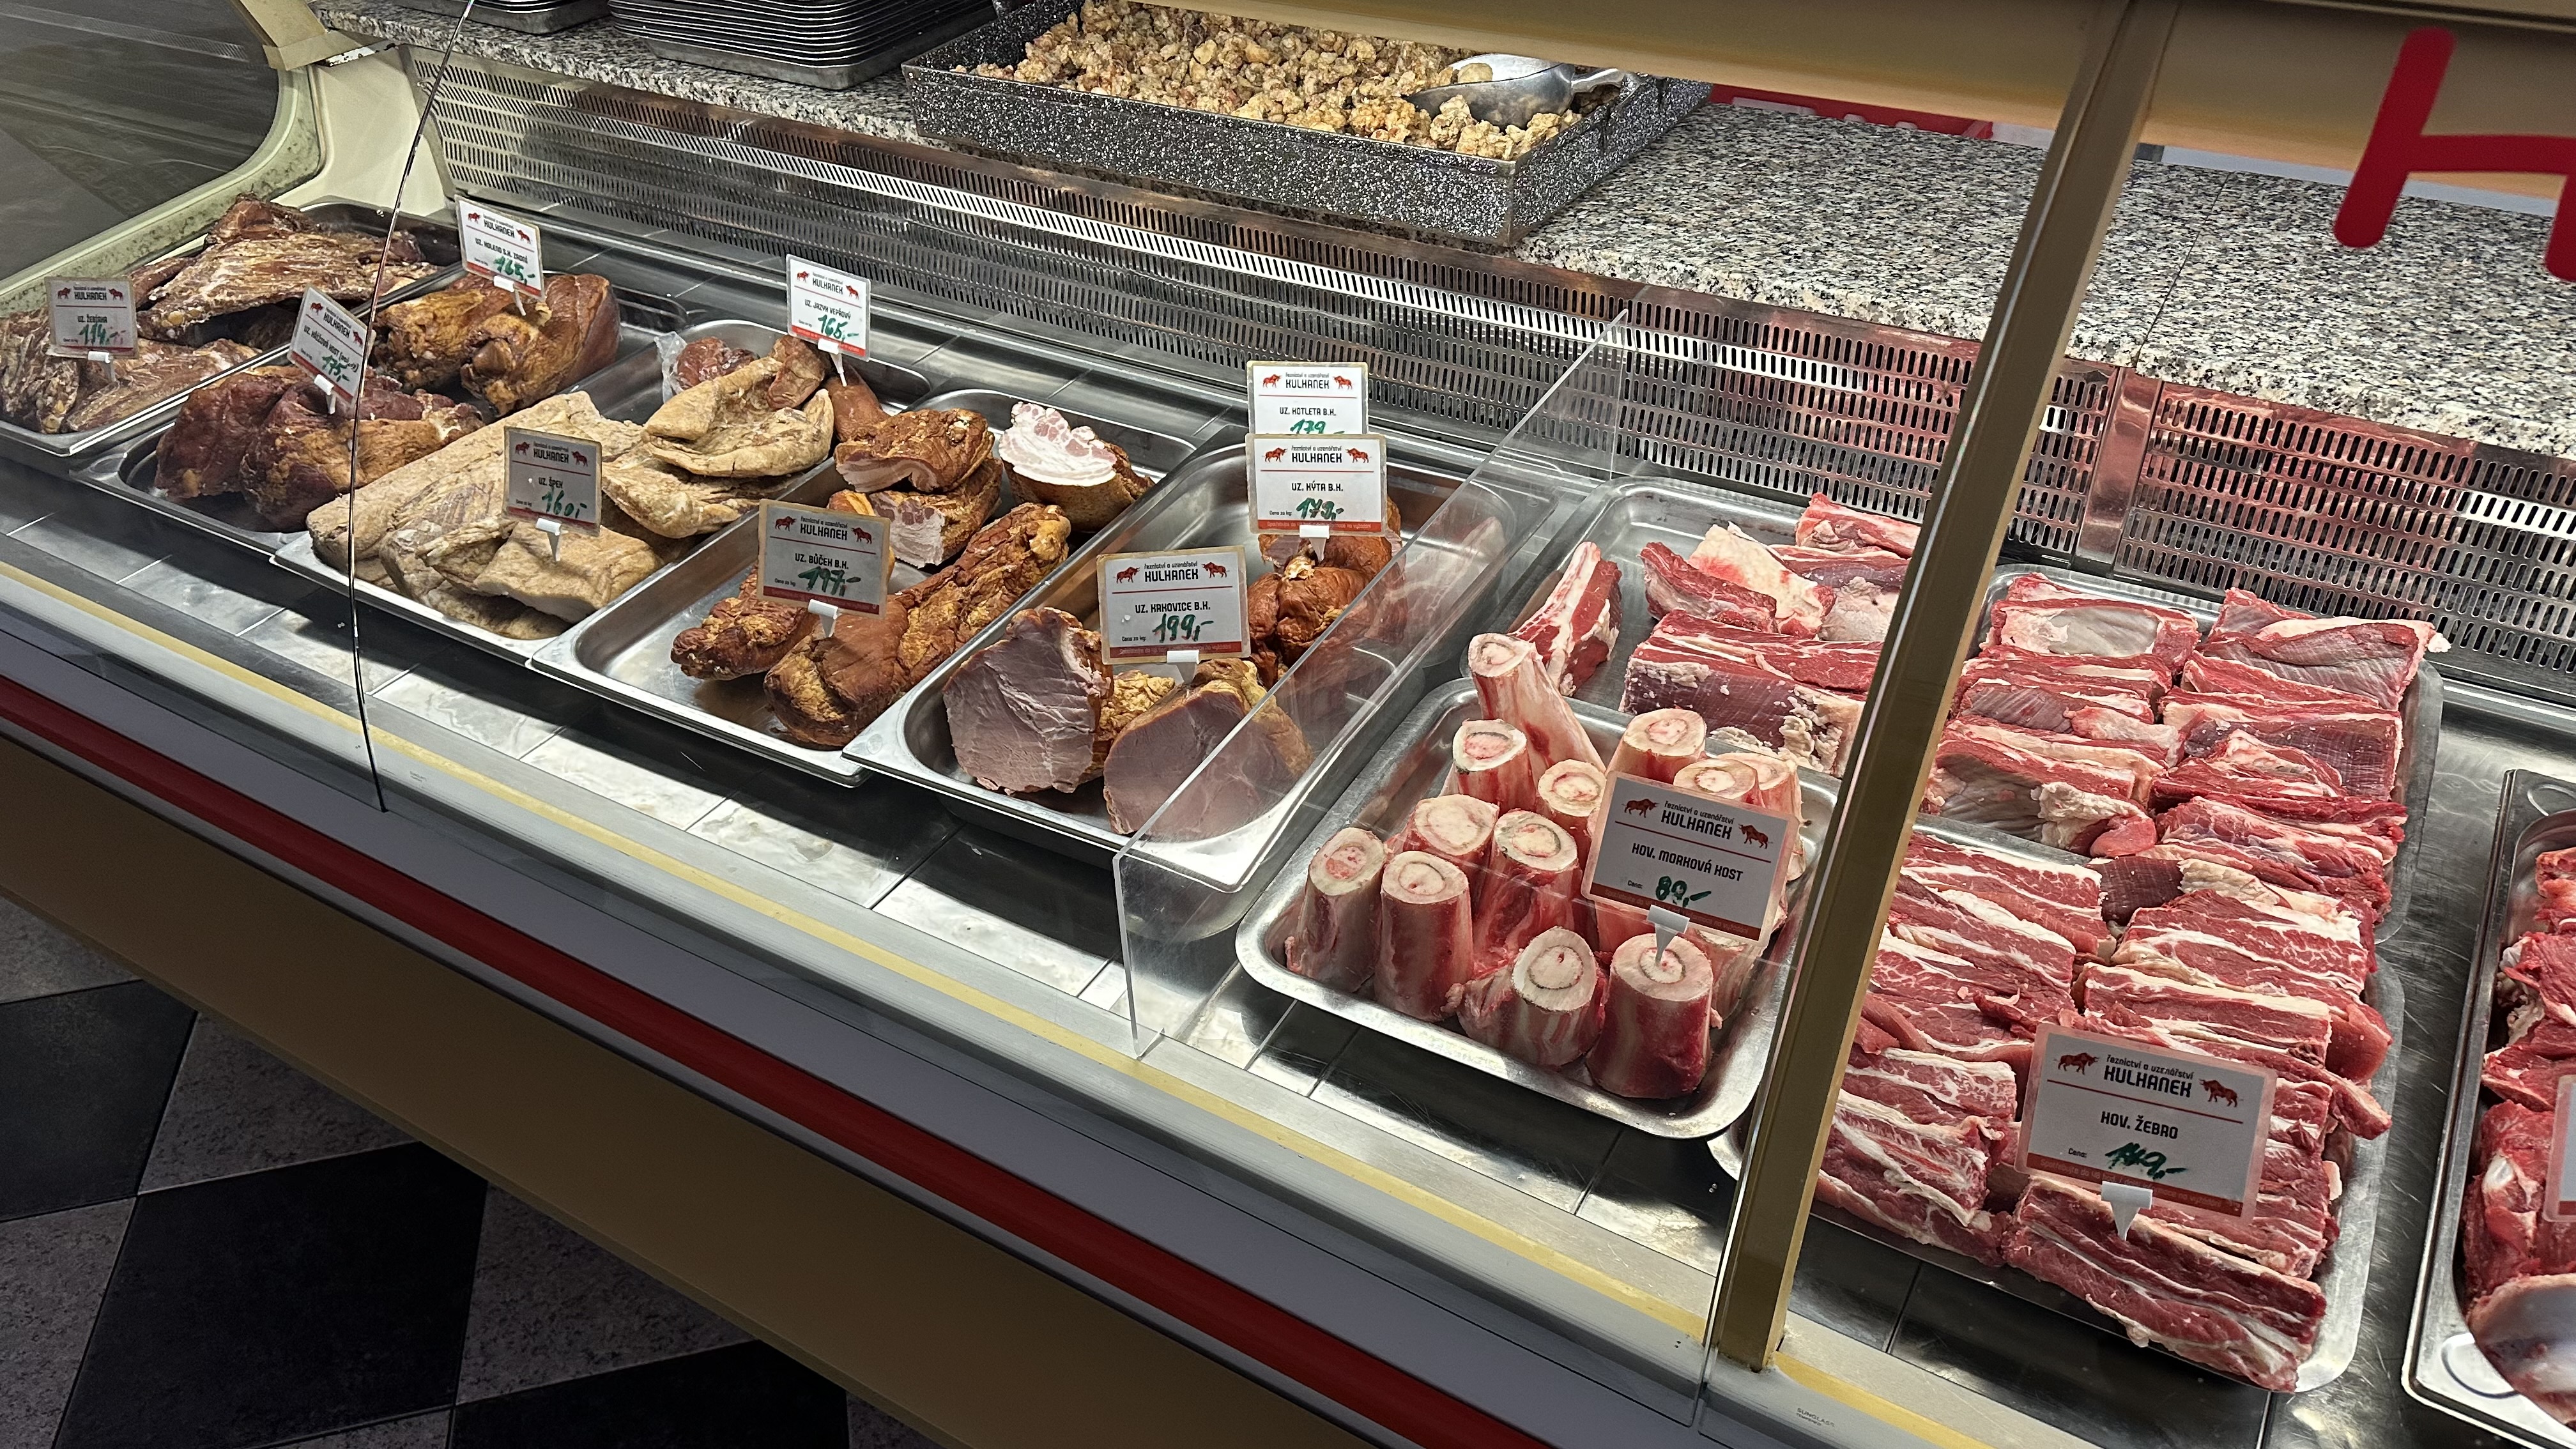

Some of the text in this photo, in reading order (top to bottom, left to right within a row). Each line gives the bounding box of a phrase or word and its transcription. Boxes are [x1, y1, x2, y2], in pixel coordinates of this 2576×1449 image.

[1285, 379, 1329, 389] KULHANEK
[1280, 407, 1290, 415] UZ.
[1292, 452, 1342, 463] KULHANEK
[1292, 482, 1304, 491] UZ.
[1306, 480, 1326, 491] KÝTA
[800, 523, 848, 540] KULHANEK
[795, 553, 807, 563] UZ.
[809, 553, 832, 567] BŮČEK
[1144, 569, 1198, 582] KULHANEK
[1135, 604, 1149, 613] UZ.
[1151, 602, 1192, 613] KRKOVICE
[1664, 801, 1692, 814] řeznictví
[1699, 810, 1735, 825] uzenářství
[1660, 810, 1733, 840] KULHANEK
[1631, 843, 1744, 882] HOV. MORKOVÁ KOST
[2106, 1054, 2142, 1068] řeznictví
[2150, 1063, 2193, 1080] uzenářství
[2104, 1065, 2192, 1098] KULHANEK
[2100, 1111, 2178, 1140] HOV. ŽEBRO
[2068, 1147, 2087, 1158] Cena:
